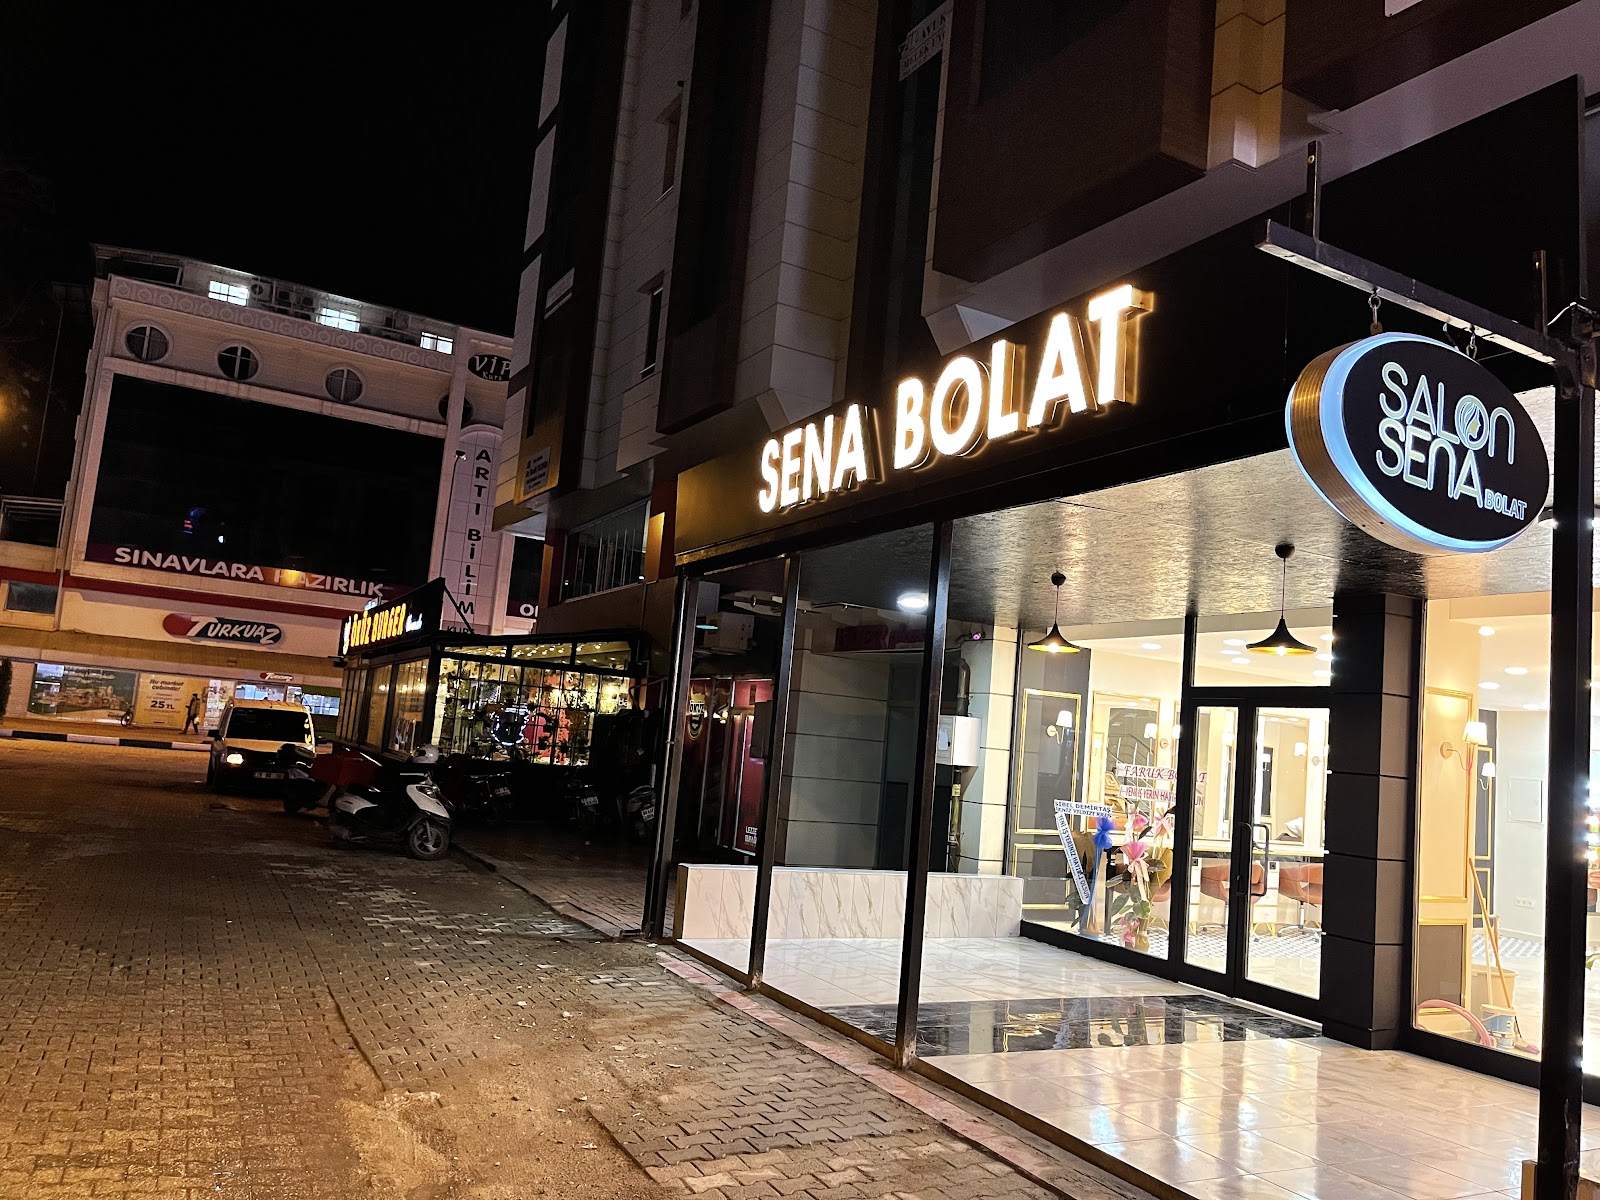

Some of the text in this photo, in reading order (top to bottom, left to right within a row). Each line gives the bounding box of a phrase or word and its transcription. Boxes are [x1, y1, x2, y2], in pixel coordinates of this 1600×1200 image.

[758, 284, 1143, 514] SENA BOLAT
[474, 449, 492, 516] ARTI
[1484, 488, 1528, 521] BOLAT
[114, 546, 265, 583] SINAVLARA
[371, 602, 407, 643] BURGER
[150, 700, 166, 708] 25
[1124, 765, 1167, 780] FARUK
